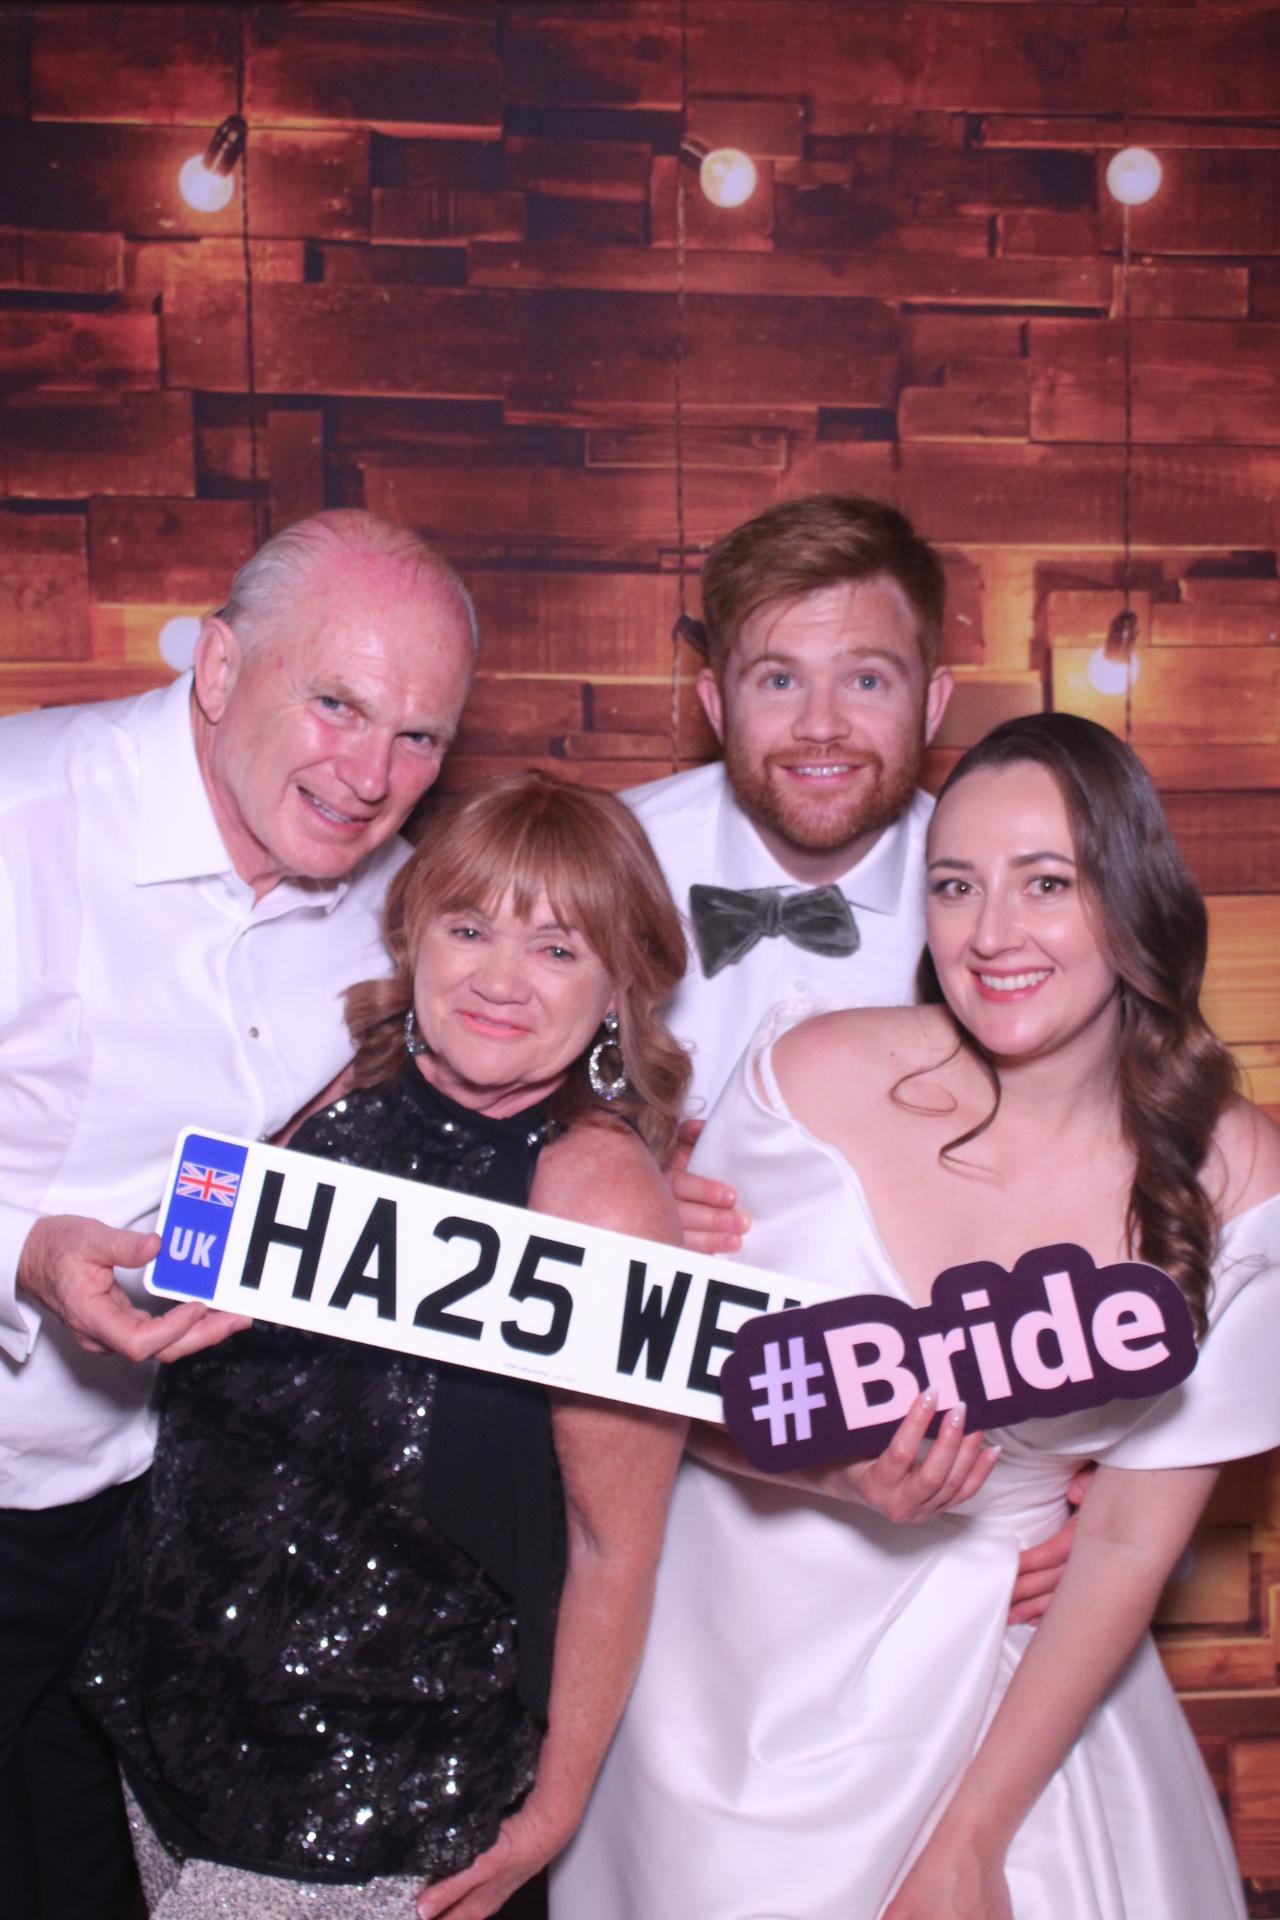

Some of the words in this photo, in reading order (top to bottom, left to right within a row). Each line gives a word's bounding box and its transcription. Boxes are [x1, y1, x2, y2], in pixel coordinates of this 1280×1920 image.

[169, 1226, 218, 1268] UK
[240, 1170, 585, 1356] HA25
[616, 1259, 802, 1395] WE
[749, 1271, 1171, 1447] #Bride
